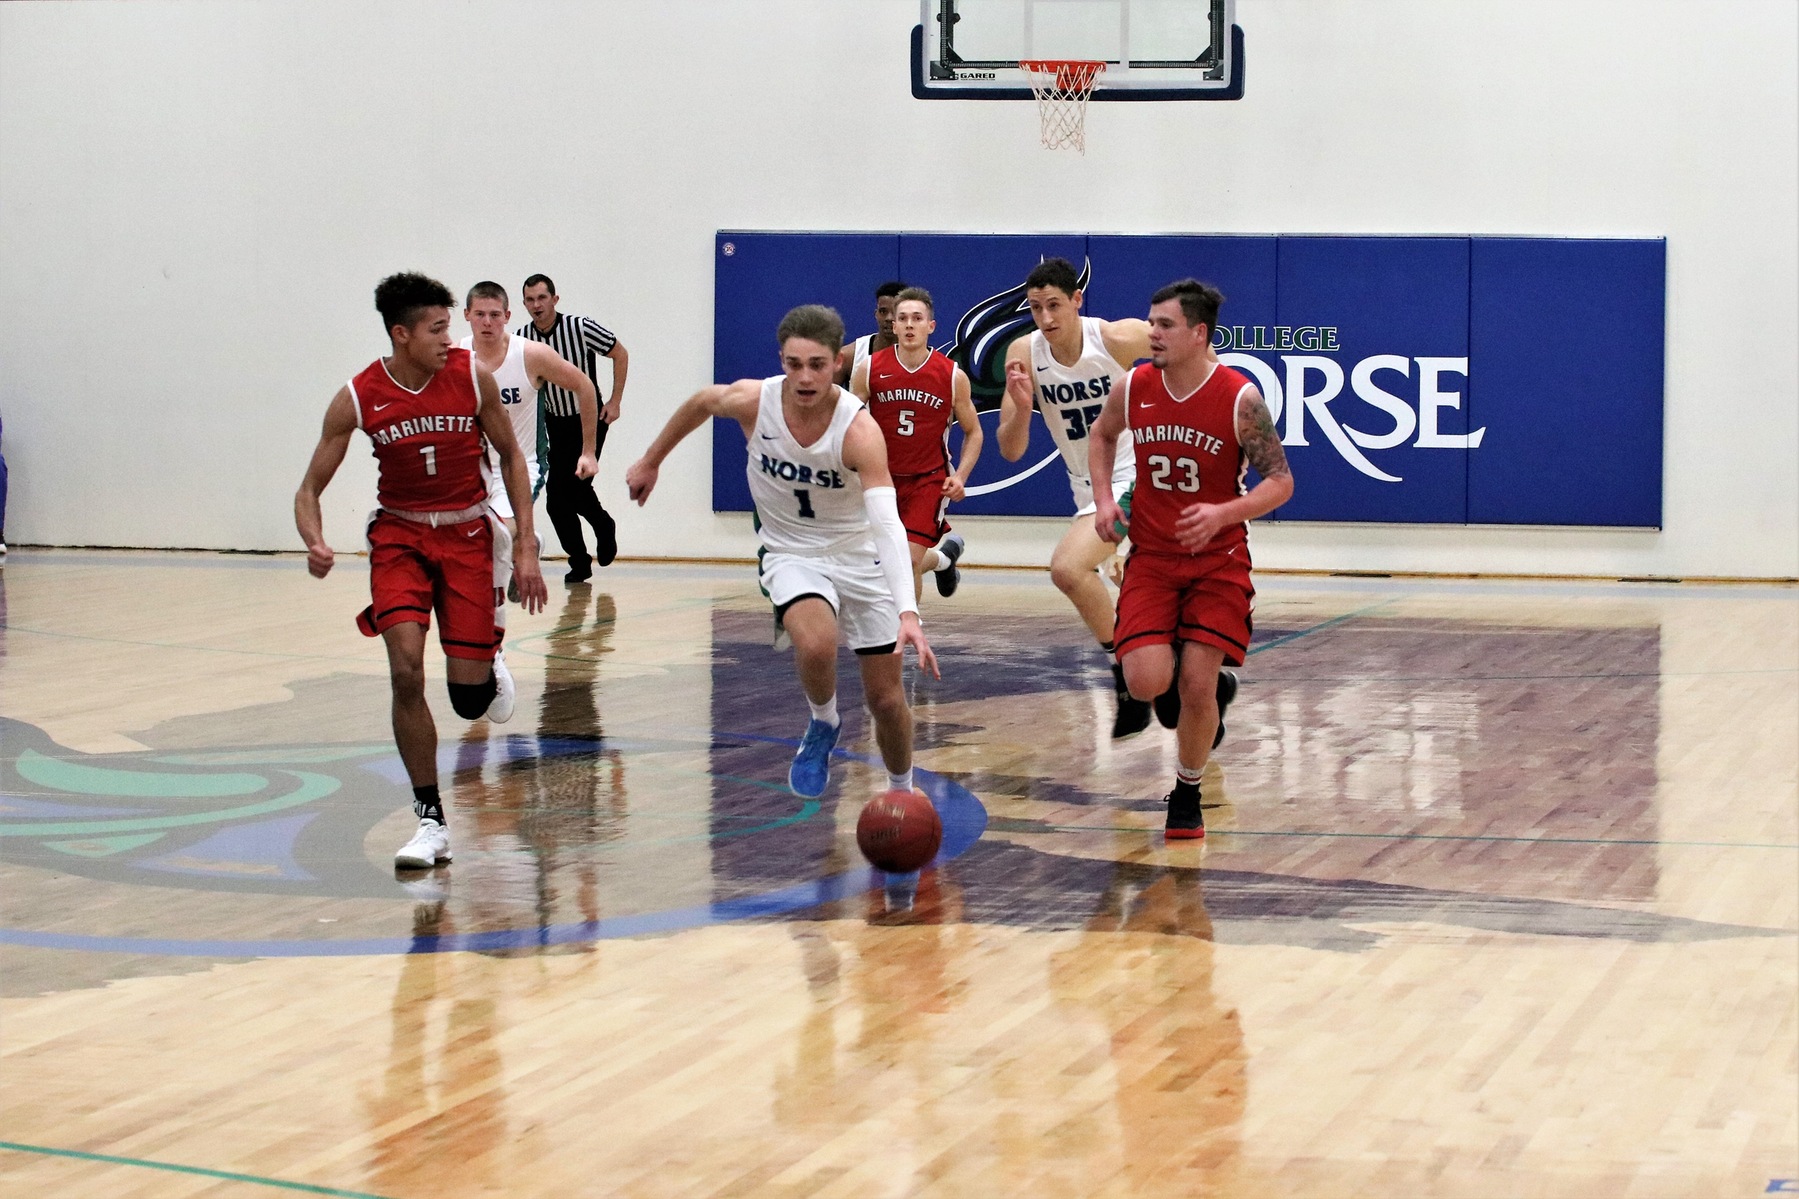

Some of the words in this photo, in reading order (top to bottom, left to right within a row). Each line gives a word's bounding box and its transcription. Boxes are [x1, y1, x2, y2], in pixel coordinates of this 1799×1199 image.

[876, 387, 944, 410] MARINETTE
[1040, 374, 1112, 405] NORSE
[371, 415, 475, 446] MARINETTE
[896, 410, 916, 437] 5
[1133, 424, 1224, 456] MARINETTE
[419, 445, 438, 477] 1
[760, 452, 845, 489] NORSE
[1148, 454, 1201, 494] 23
[793, 488, 816, 519] 1
